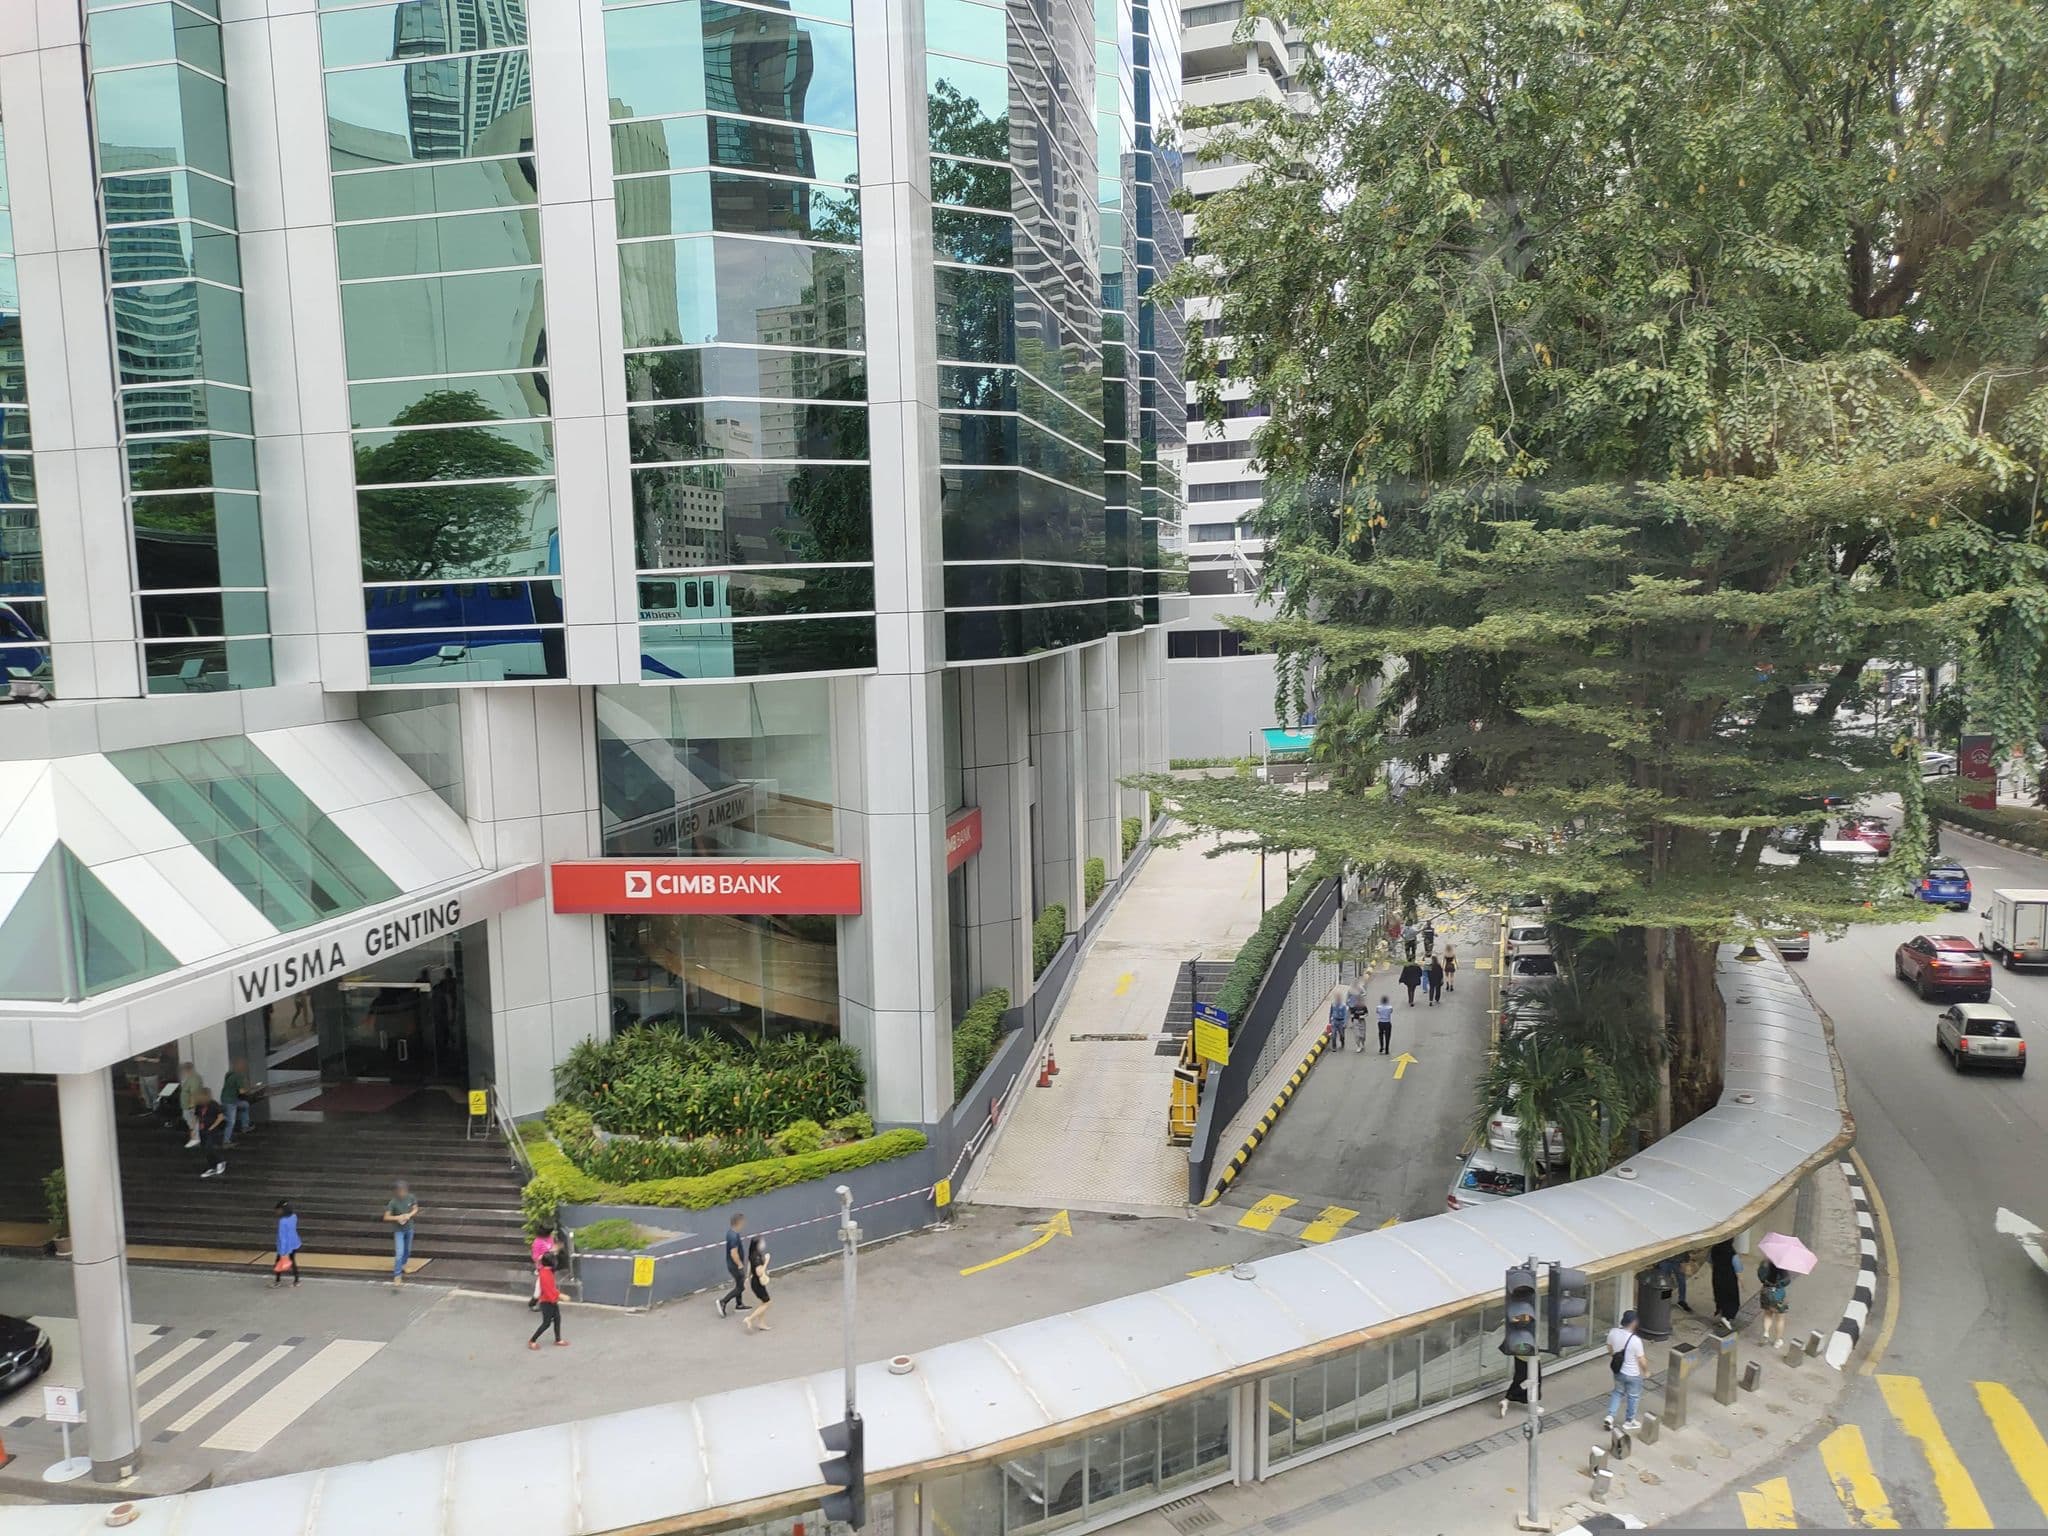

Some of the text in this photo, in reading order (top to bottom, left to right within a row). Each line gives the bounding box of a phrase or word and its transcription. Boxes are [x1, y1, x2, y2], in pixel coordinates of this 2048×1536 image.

[655, 874, 783, 895] CIMB BANK
[239, 900, 461, 1002] WISMA GENTING
